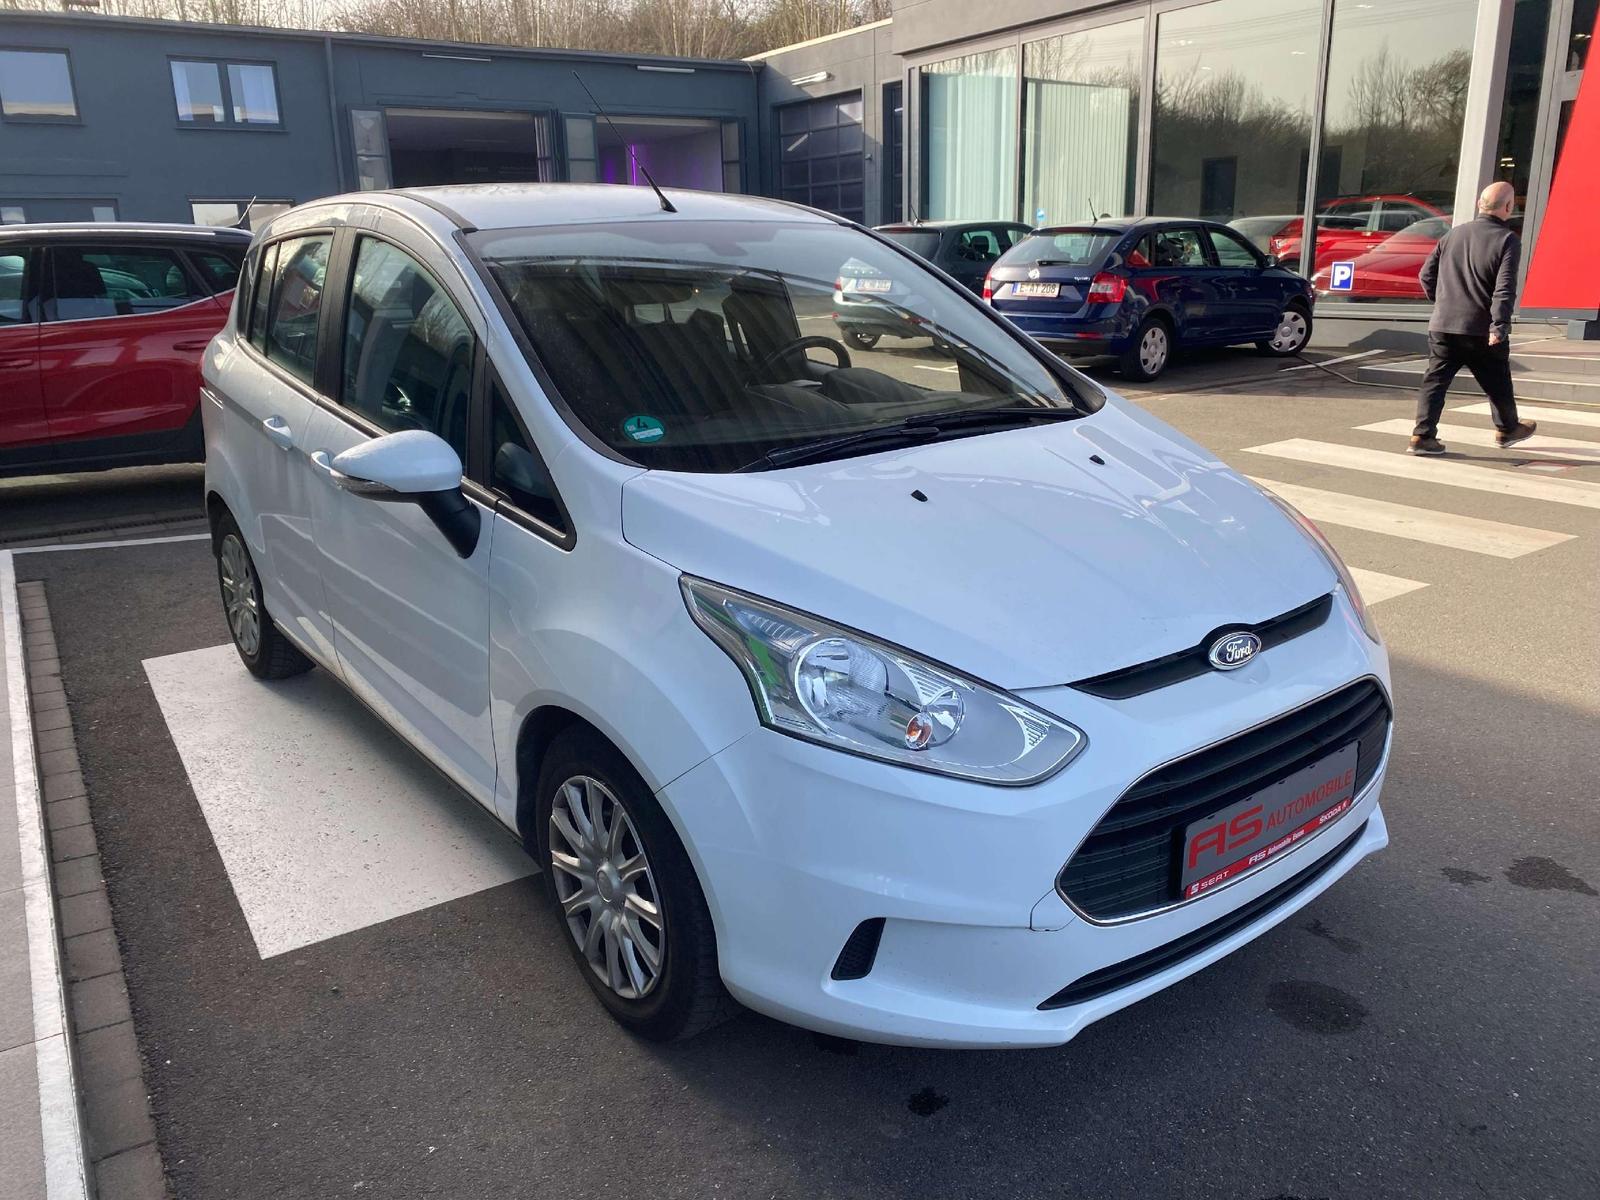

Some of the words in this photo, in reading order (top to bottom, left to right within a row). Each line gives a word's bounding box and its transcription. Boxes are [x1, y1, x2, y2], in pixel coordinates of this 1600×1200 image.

[1333, 265, 1351, 286] P
[1226, 639, 1253, 662] Ford
[1188, 804, 1264, 869] AS
[1266, 768, 1354, 832] AUTOMOBILE
[1200, 870, 1230, 890] SEAT
